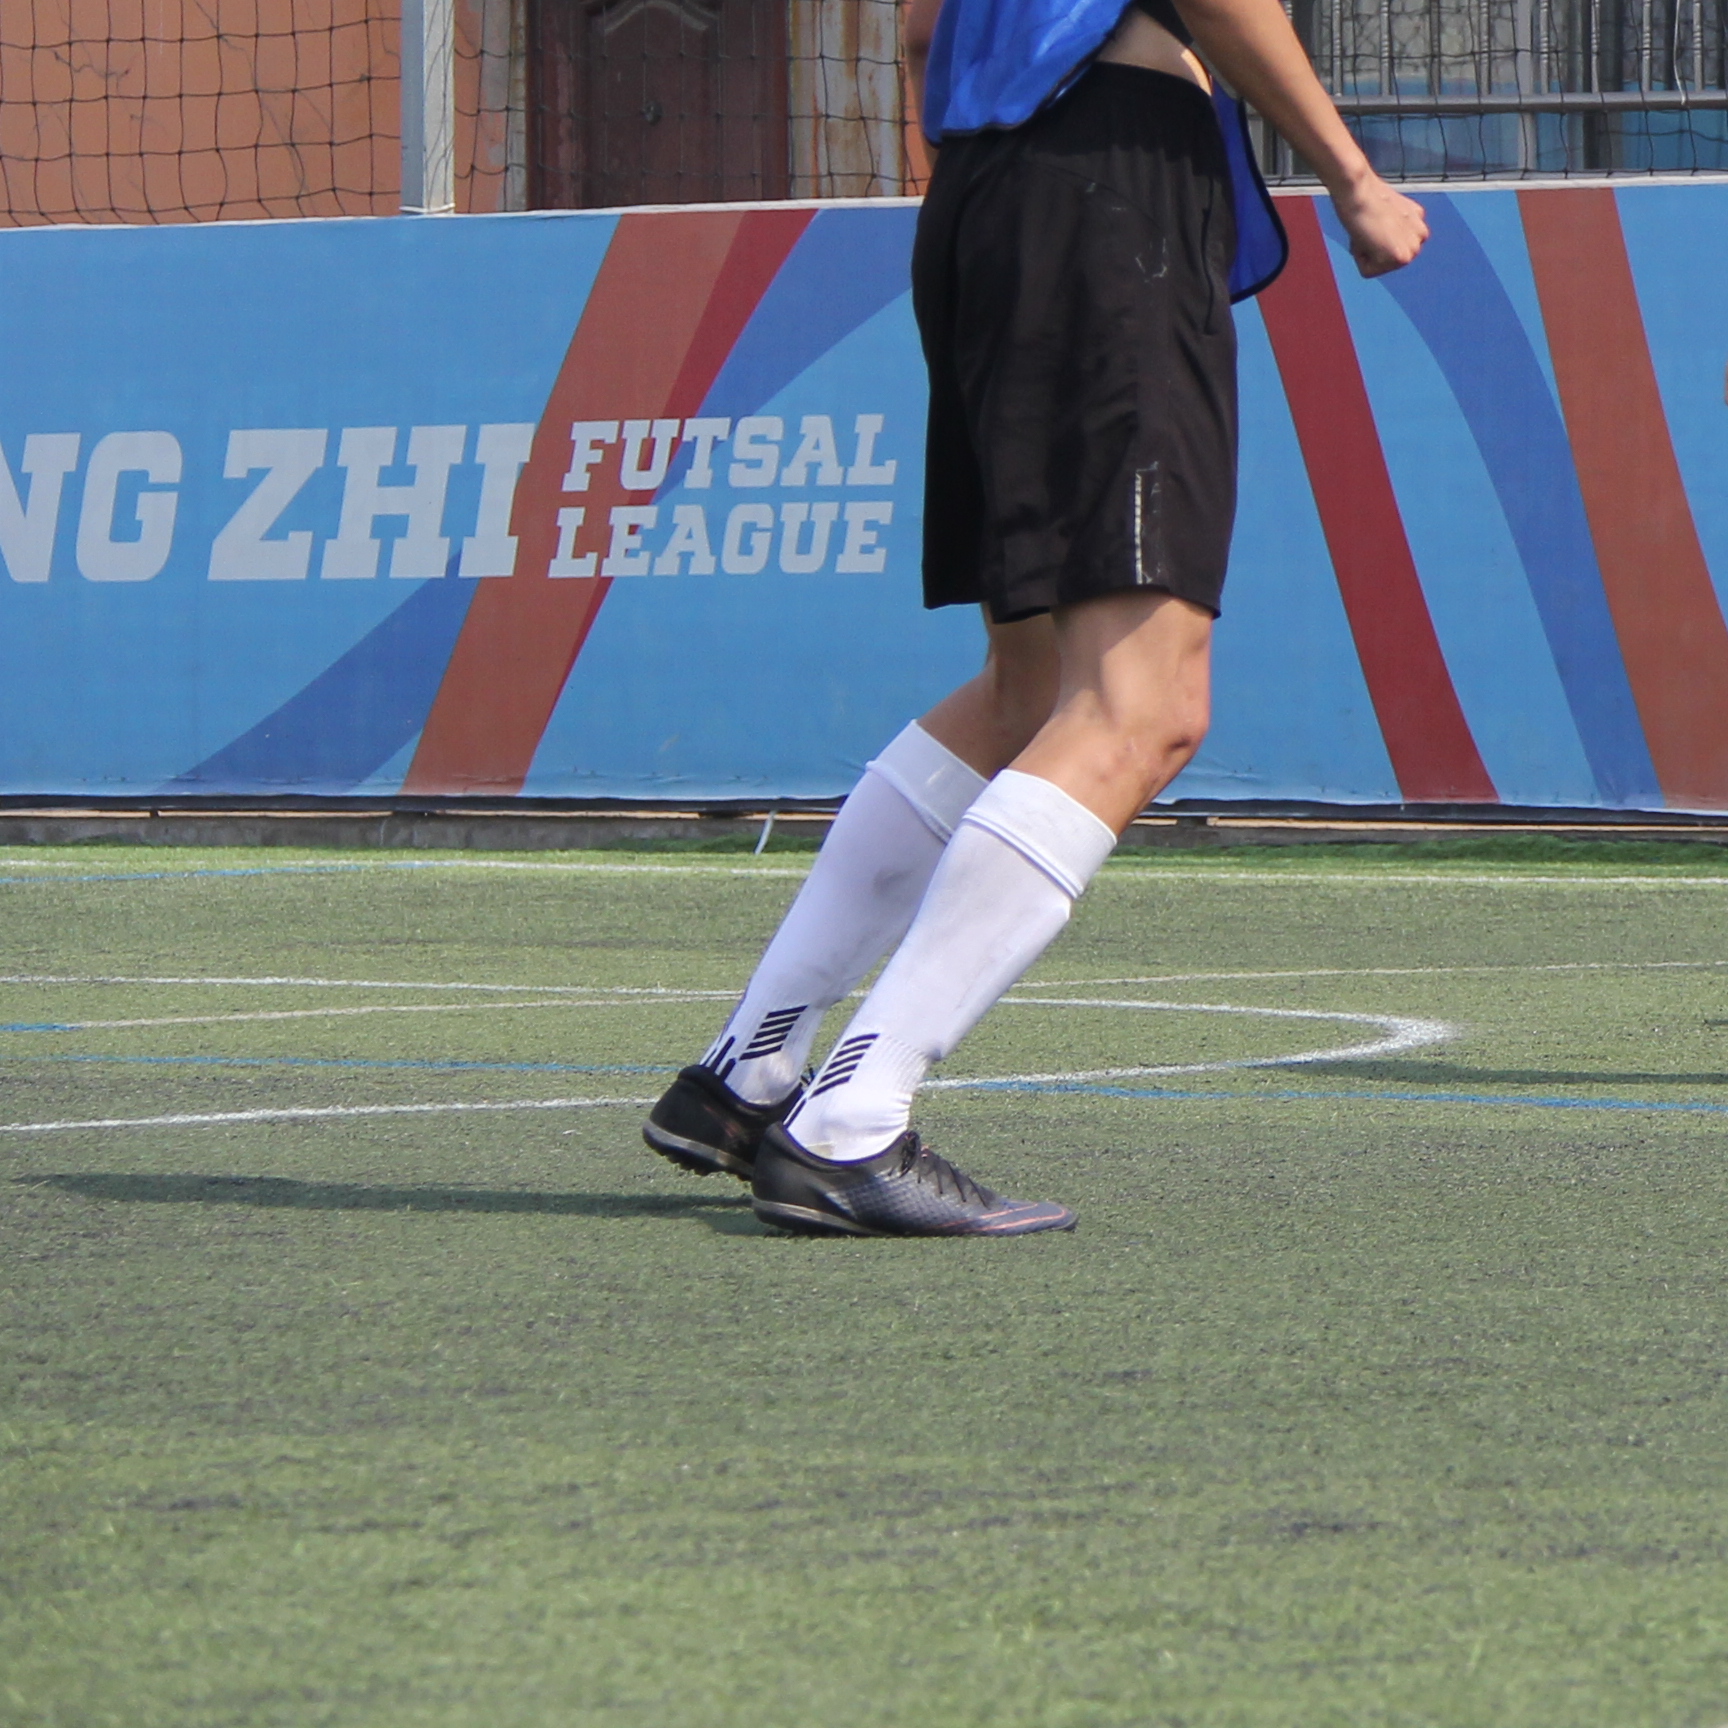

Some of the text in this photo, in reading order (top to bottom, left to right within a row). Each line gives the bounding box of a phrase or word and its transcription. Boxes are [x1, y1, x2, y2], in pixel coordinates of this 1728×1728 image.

[561, 413, 897, 491] FUTSAL
[205, 422, 536, 582] ZHI
[548, 501, 894, 578] LEAGUE
